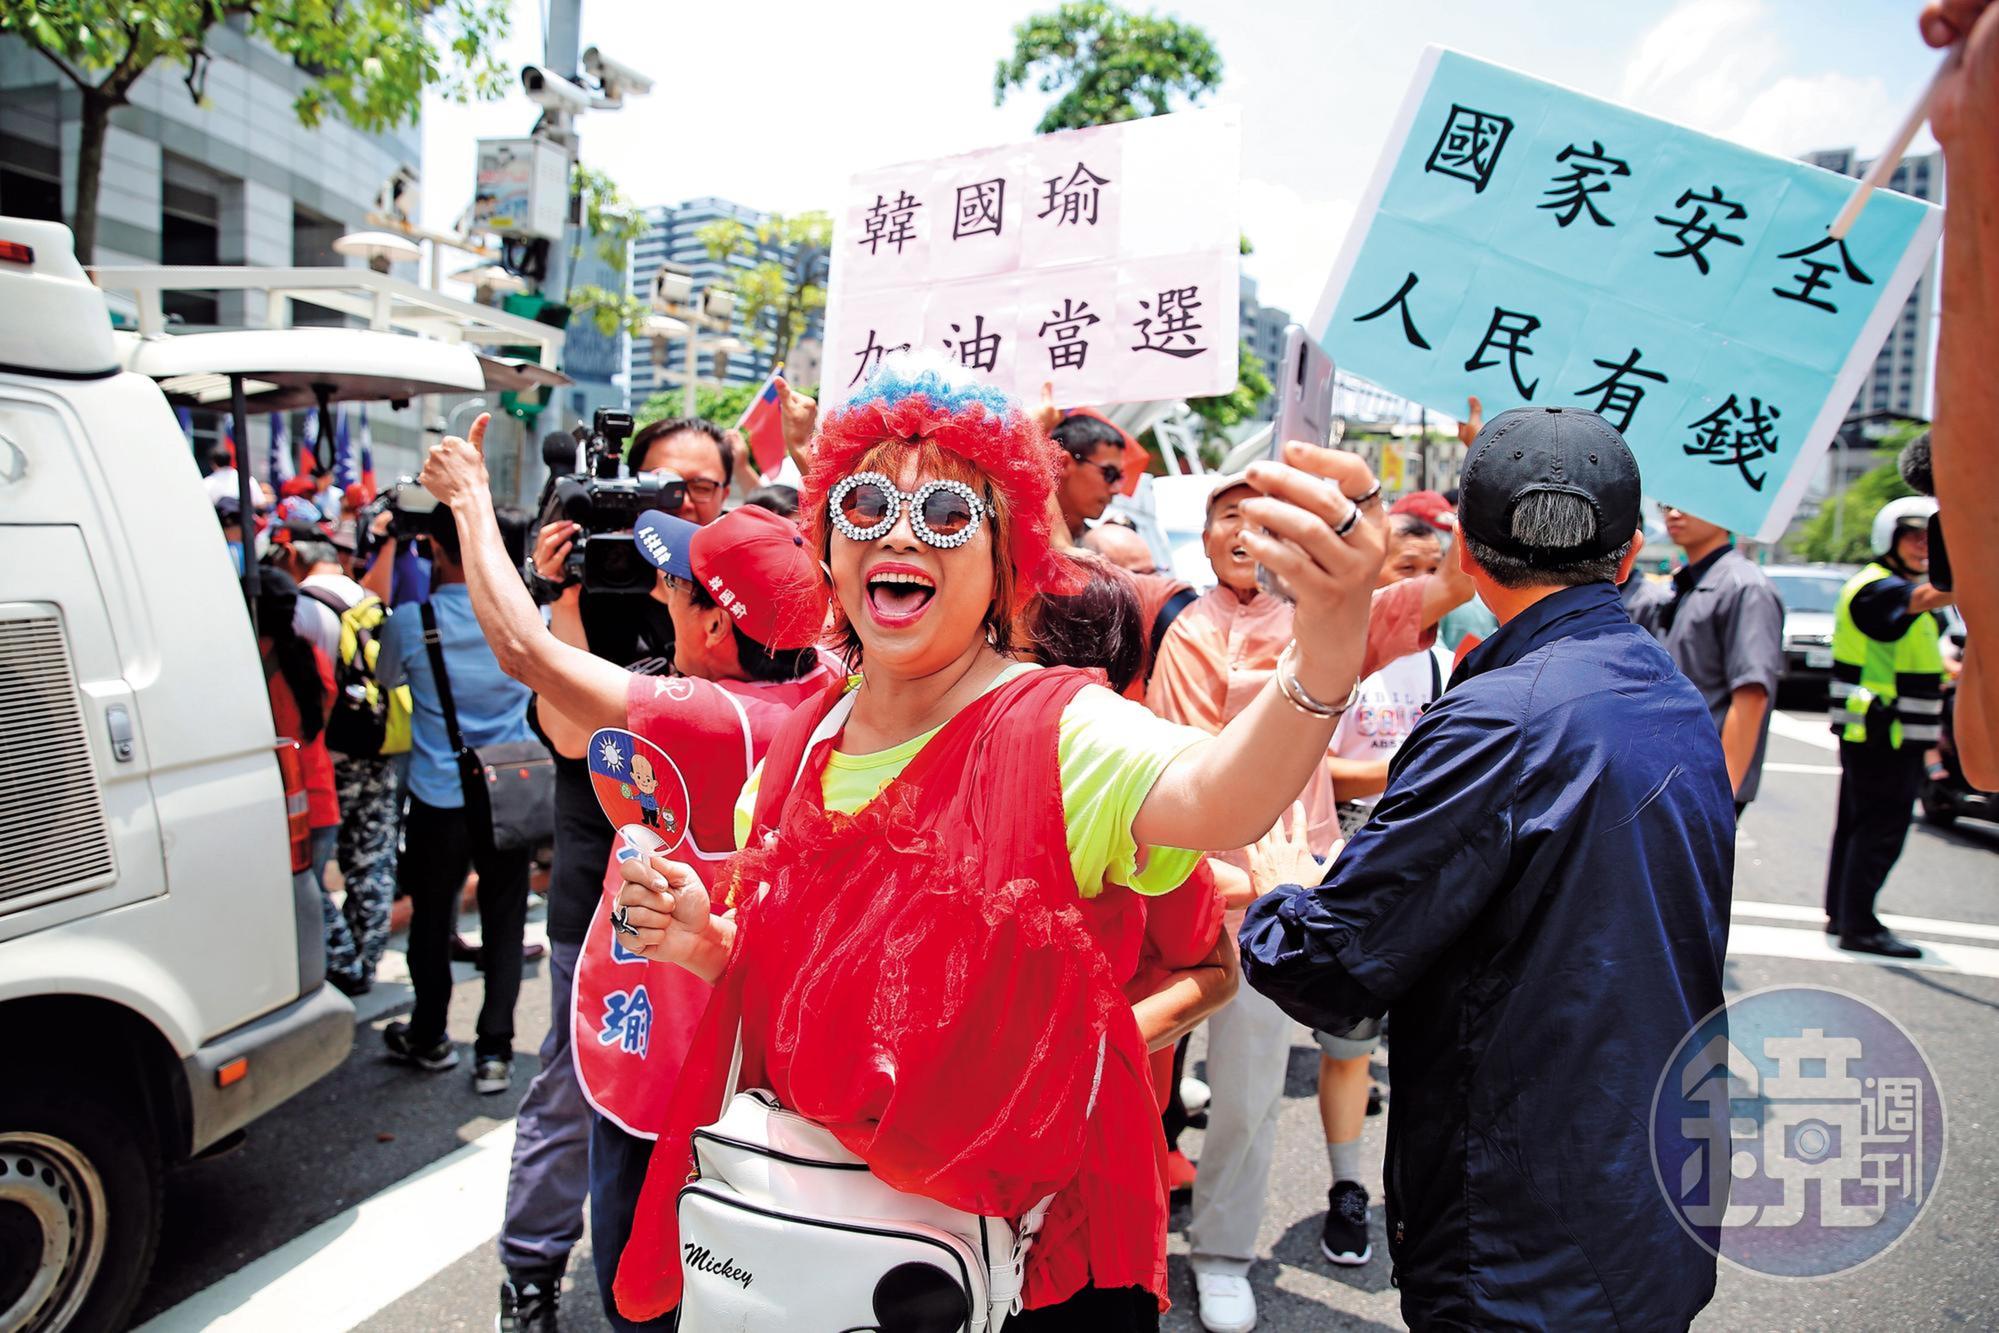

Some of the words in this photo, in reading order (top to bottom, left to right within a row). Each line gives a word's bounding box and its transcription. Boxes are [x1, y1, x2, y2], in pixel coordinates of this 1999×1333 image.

[857, 161, 1111, 255] 韓國瑜
[1424, 103, 1874, 314] 國家安全
[1353, 271, 1781, 492] 人民有錢
[708, 575, 748, 619] 韓國瑜
[684, 1242, 754, 1289] Mickey
